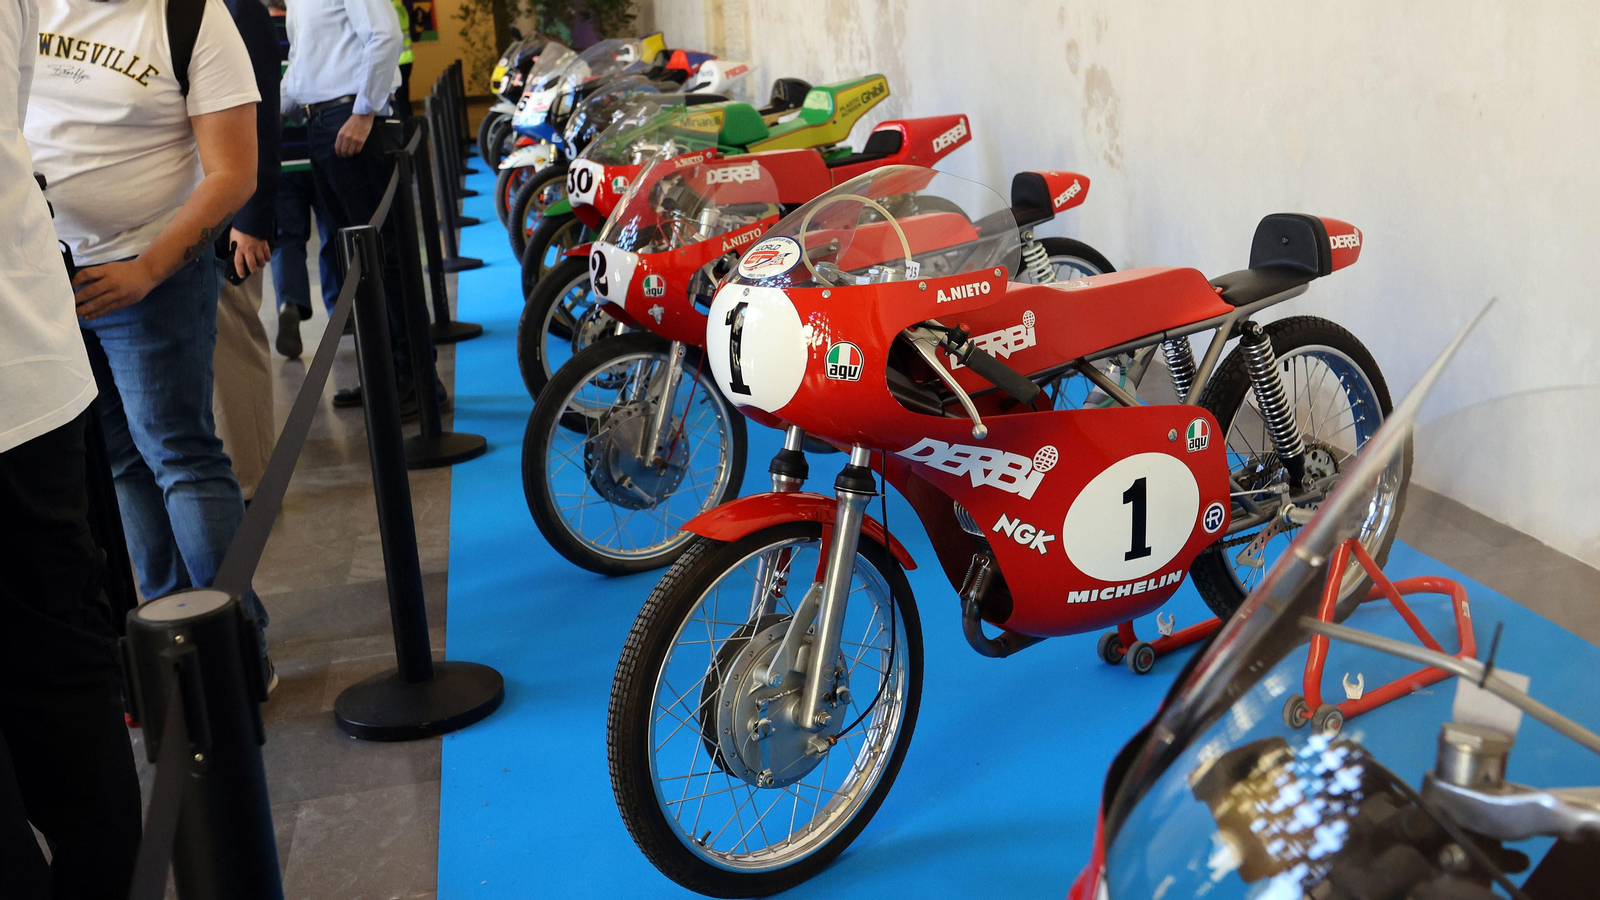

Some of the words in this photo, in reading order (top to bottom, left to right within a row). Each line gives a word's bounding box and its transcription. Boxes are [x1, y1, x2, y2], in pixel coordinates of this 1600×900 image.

[567, 167, 594, 194] 30
[722, 228, 762, 251] A.NIETO
[591, 250, 609, 297] 2
[646, 287, 663, 297] agv
[936, 281, 991, 304] A.NIETO
[725, 301, 752, 396] 1
[829, 364, 859, 379] agv
[1189, 436, 1207, 450] agv
[1122, 476, 1151, 561] 1
[992, 513, 1056, 555] NGK
[1067, 569, 1183, 603] MICHELIN
